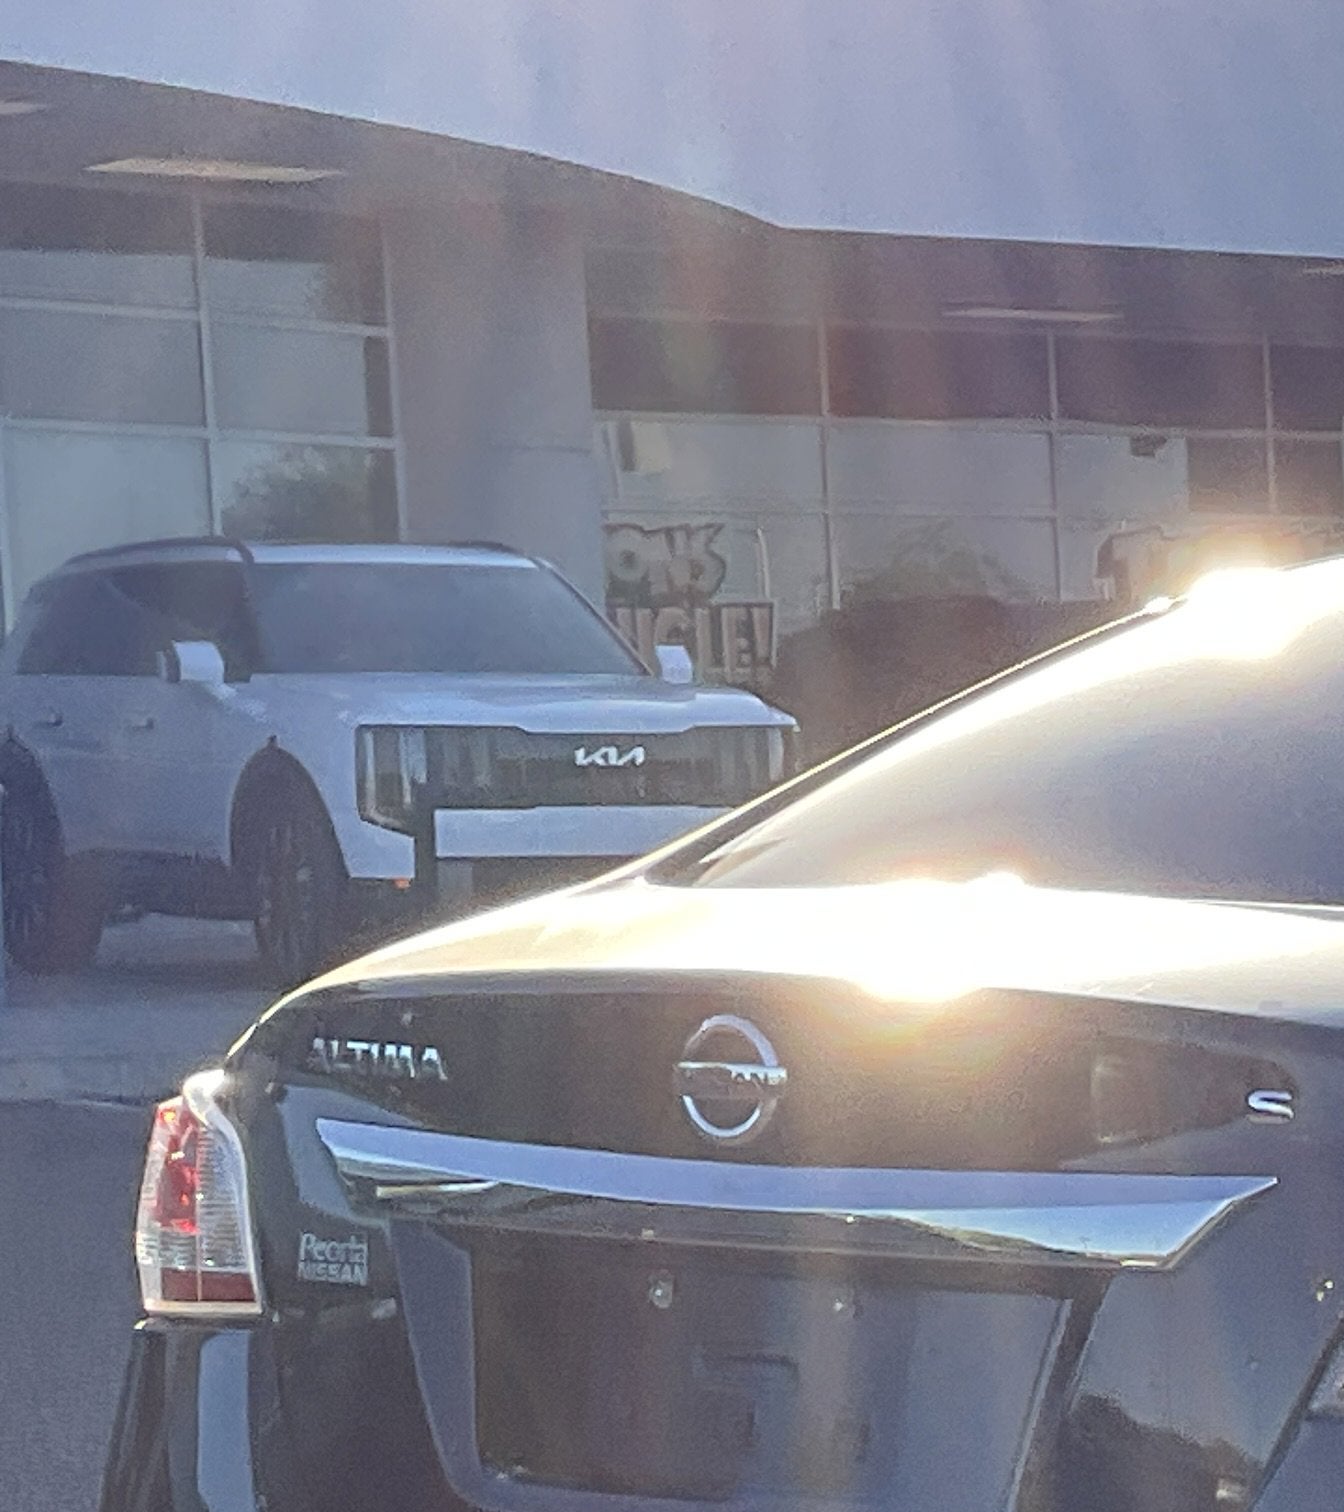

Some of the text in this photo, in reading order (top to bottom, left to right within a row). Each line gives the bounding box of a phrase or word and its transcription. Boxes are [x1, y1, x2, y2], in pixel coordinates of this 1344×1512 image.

[574, 746, 645, 766] KIA
[307, 1037, 448, 1080] ALTIMA
[1246, 1089, 1295, 1124] S
